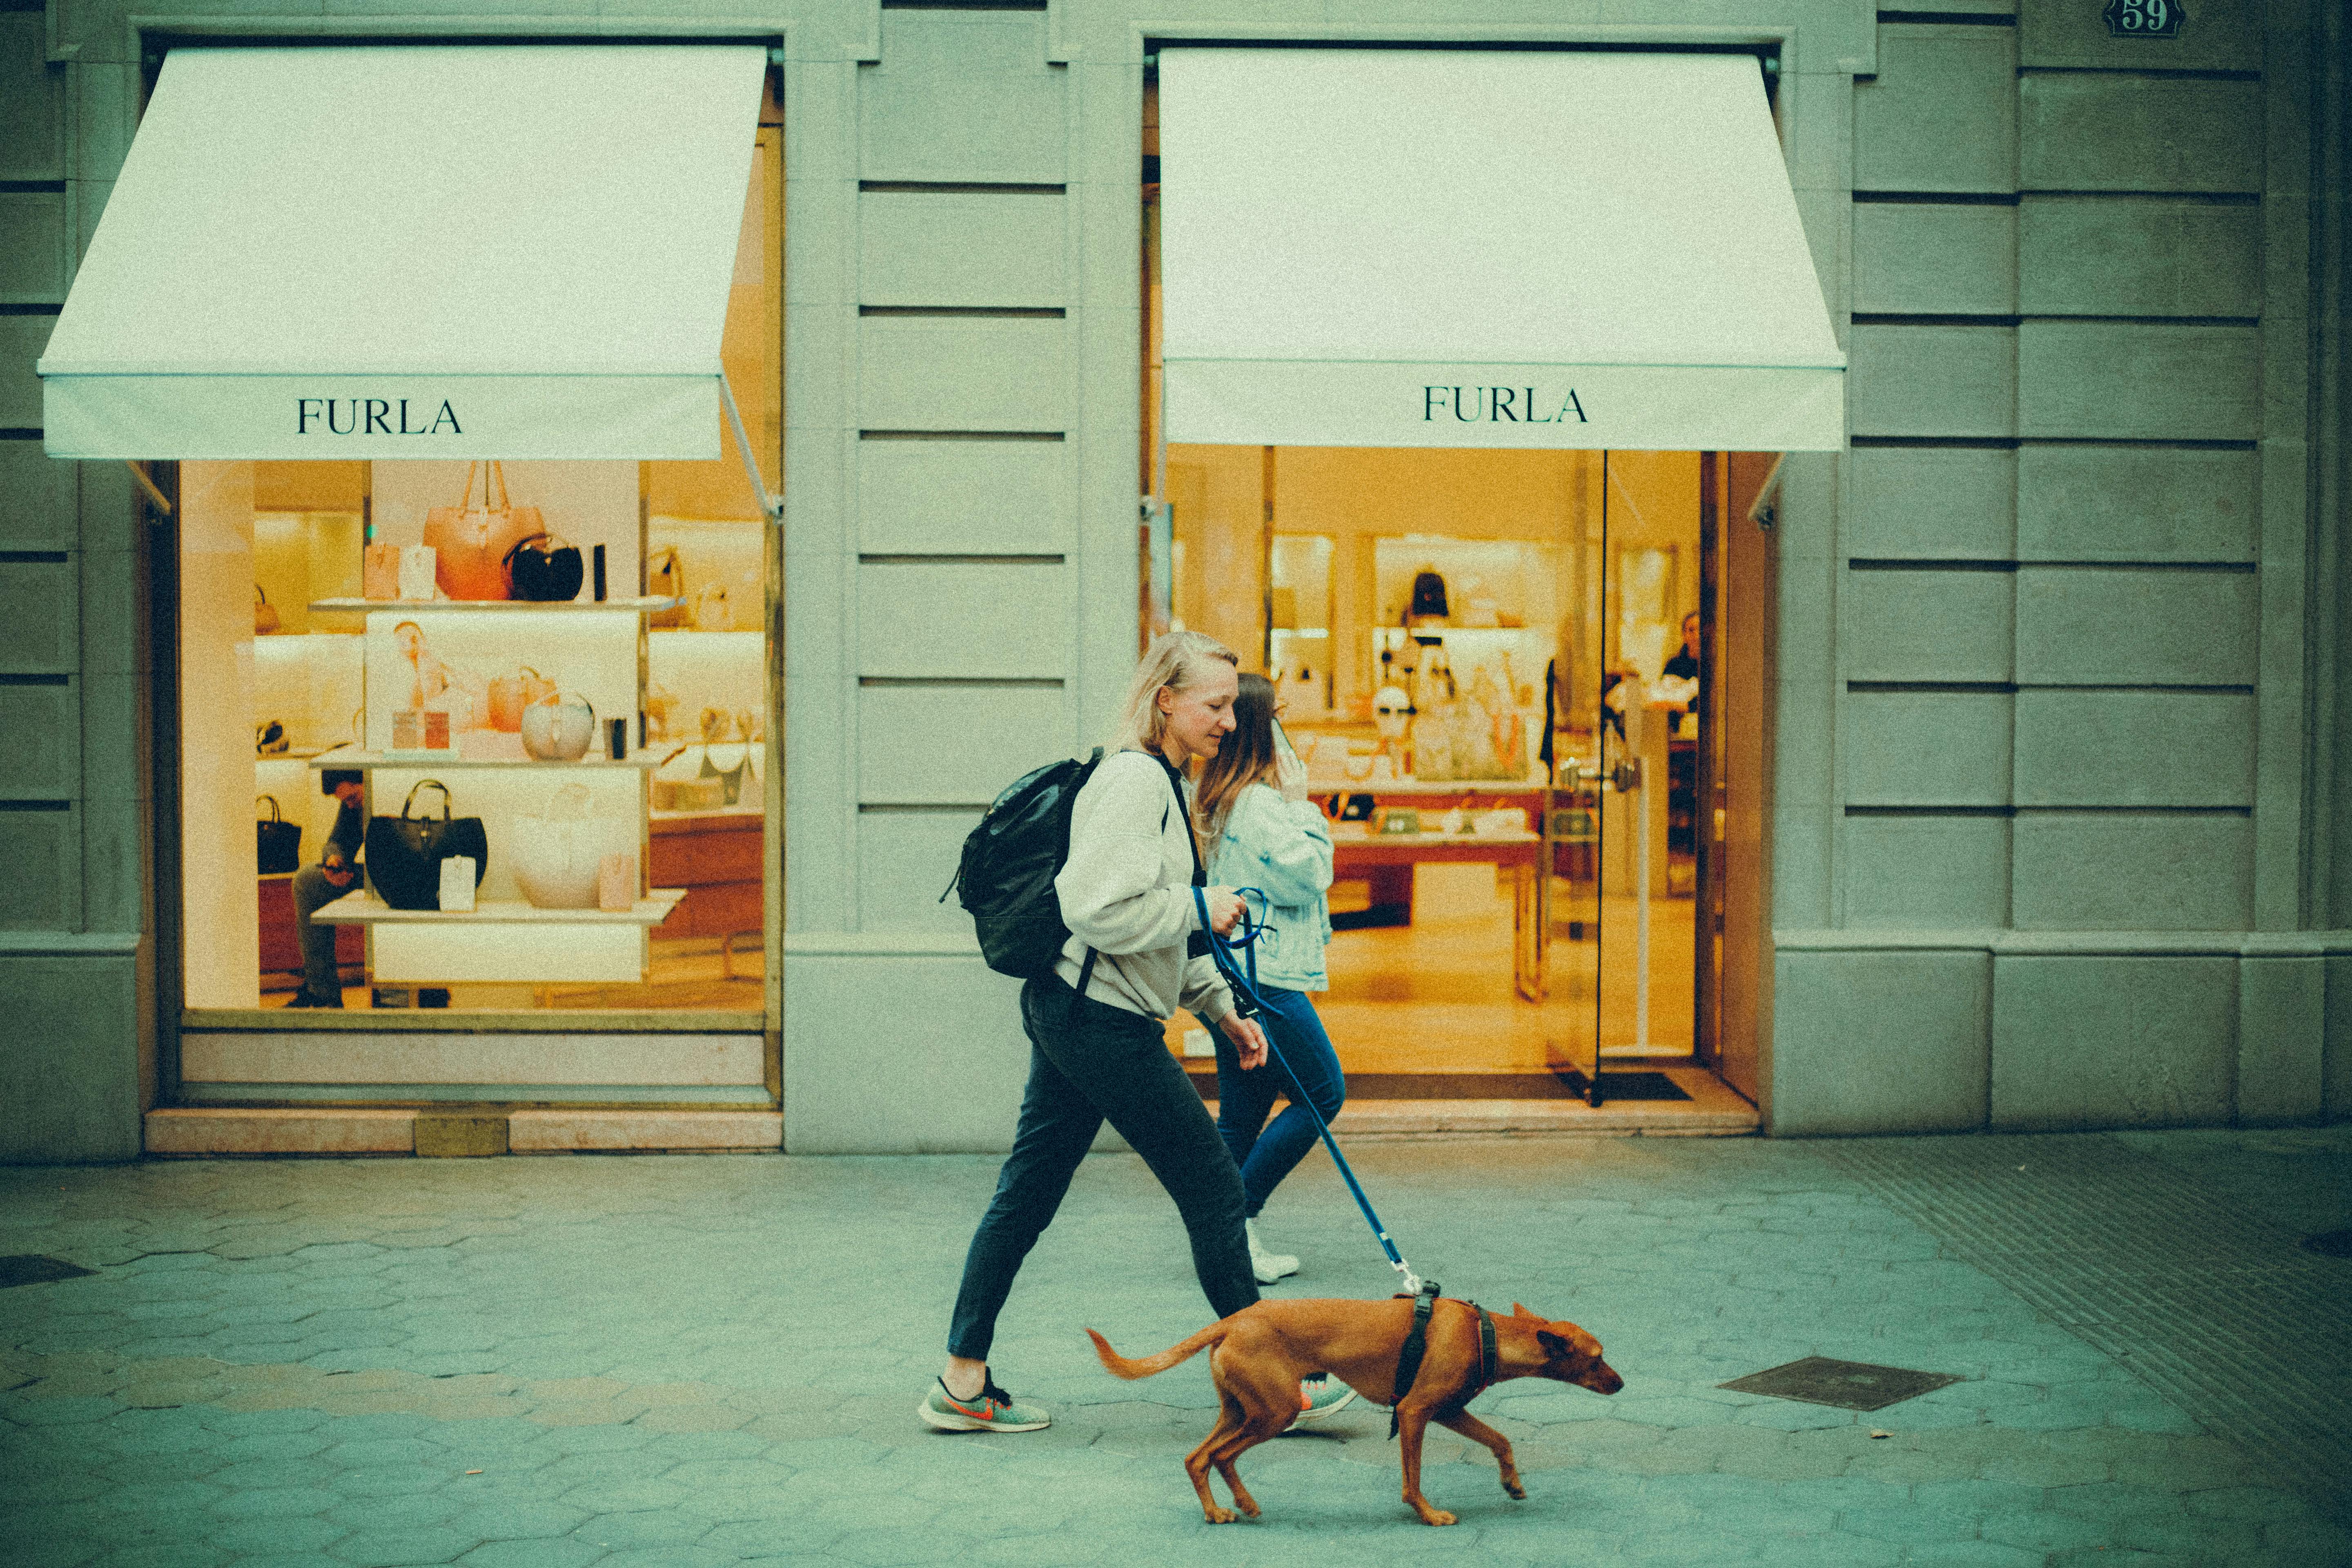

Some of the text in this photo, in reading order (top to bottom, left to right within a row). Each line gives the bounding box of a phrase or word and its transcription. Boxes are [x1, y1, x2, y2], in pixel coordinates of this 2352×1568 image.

[2122, 0, 2167, 30] 59
[297, 398, 463, 434] FURLA
[1423, 386, 1588, 422] FURLA
